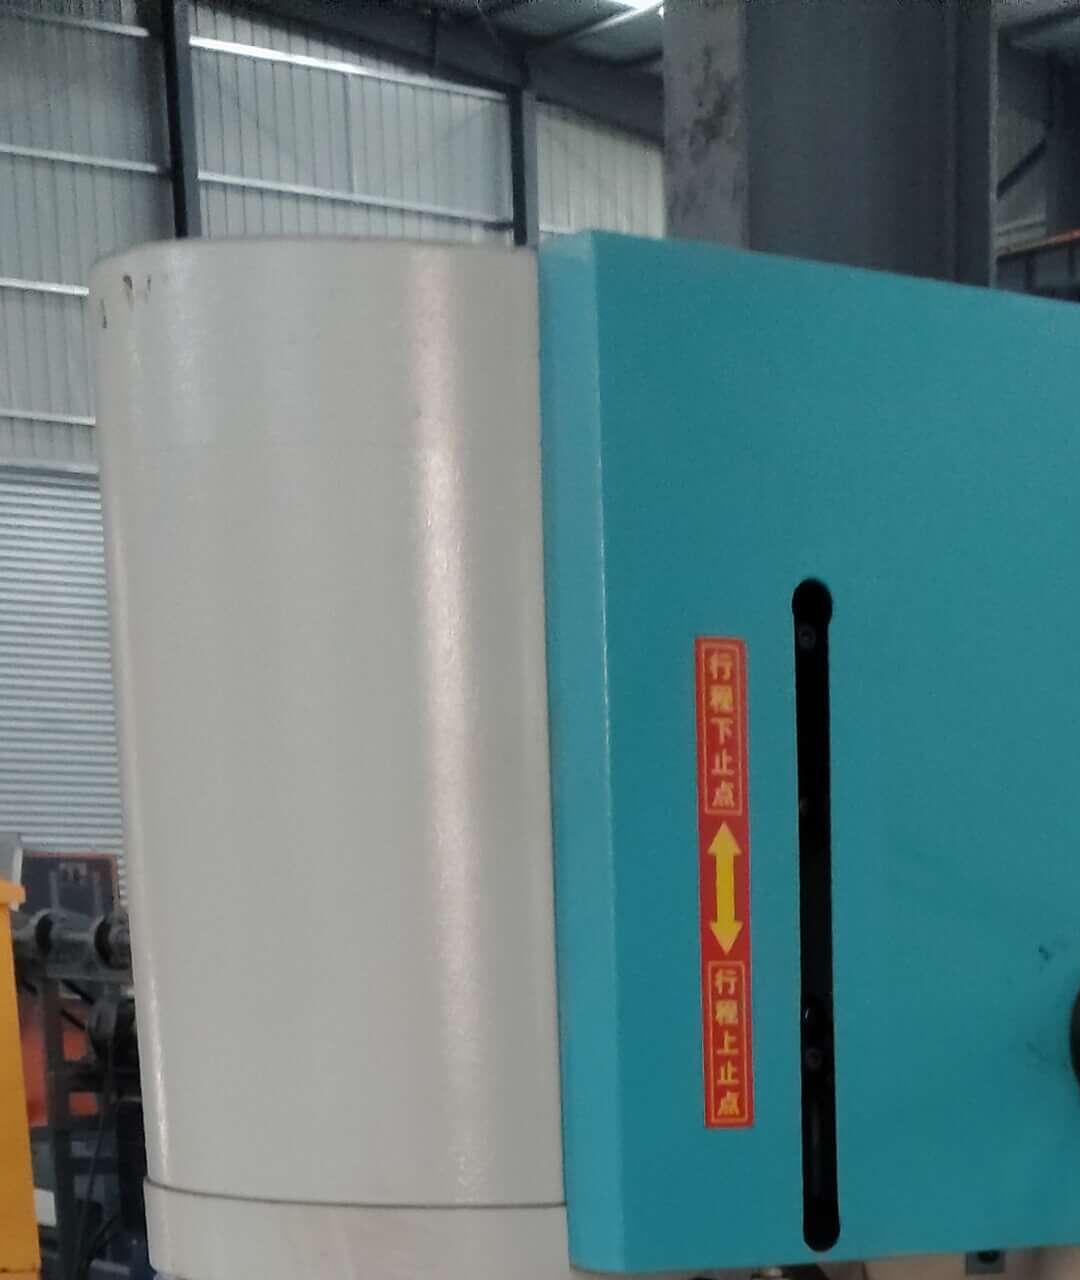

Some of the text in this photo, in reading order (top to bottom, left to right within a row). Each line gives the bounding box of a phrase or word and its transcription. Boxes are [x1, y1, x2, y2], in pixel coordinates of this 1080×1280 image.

[707, 652, 737, 808] 行程下止点
[714, 967, 741, 1117] 行程上止点
